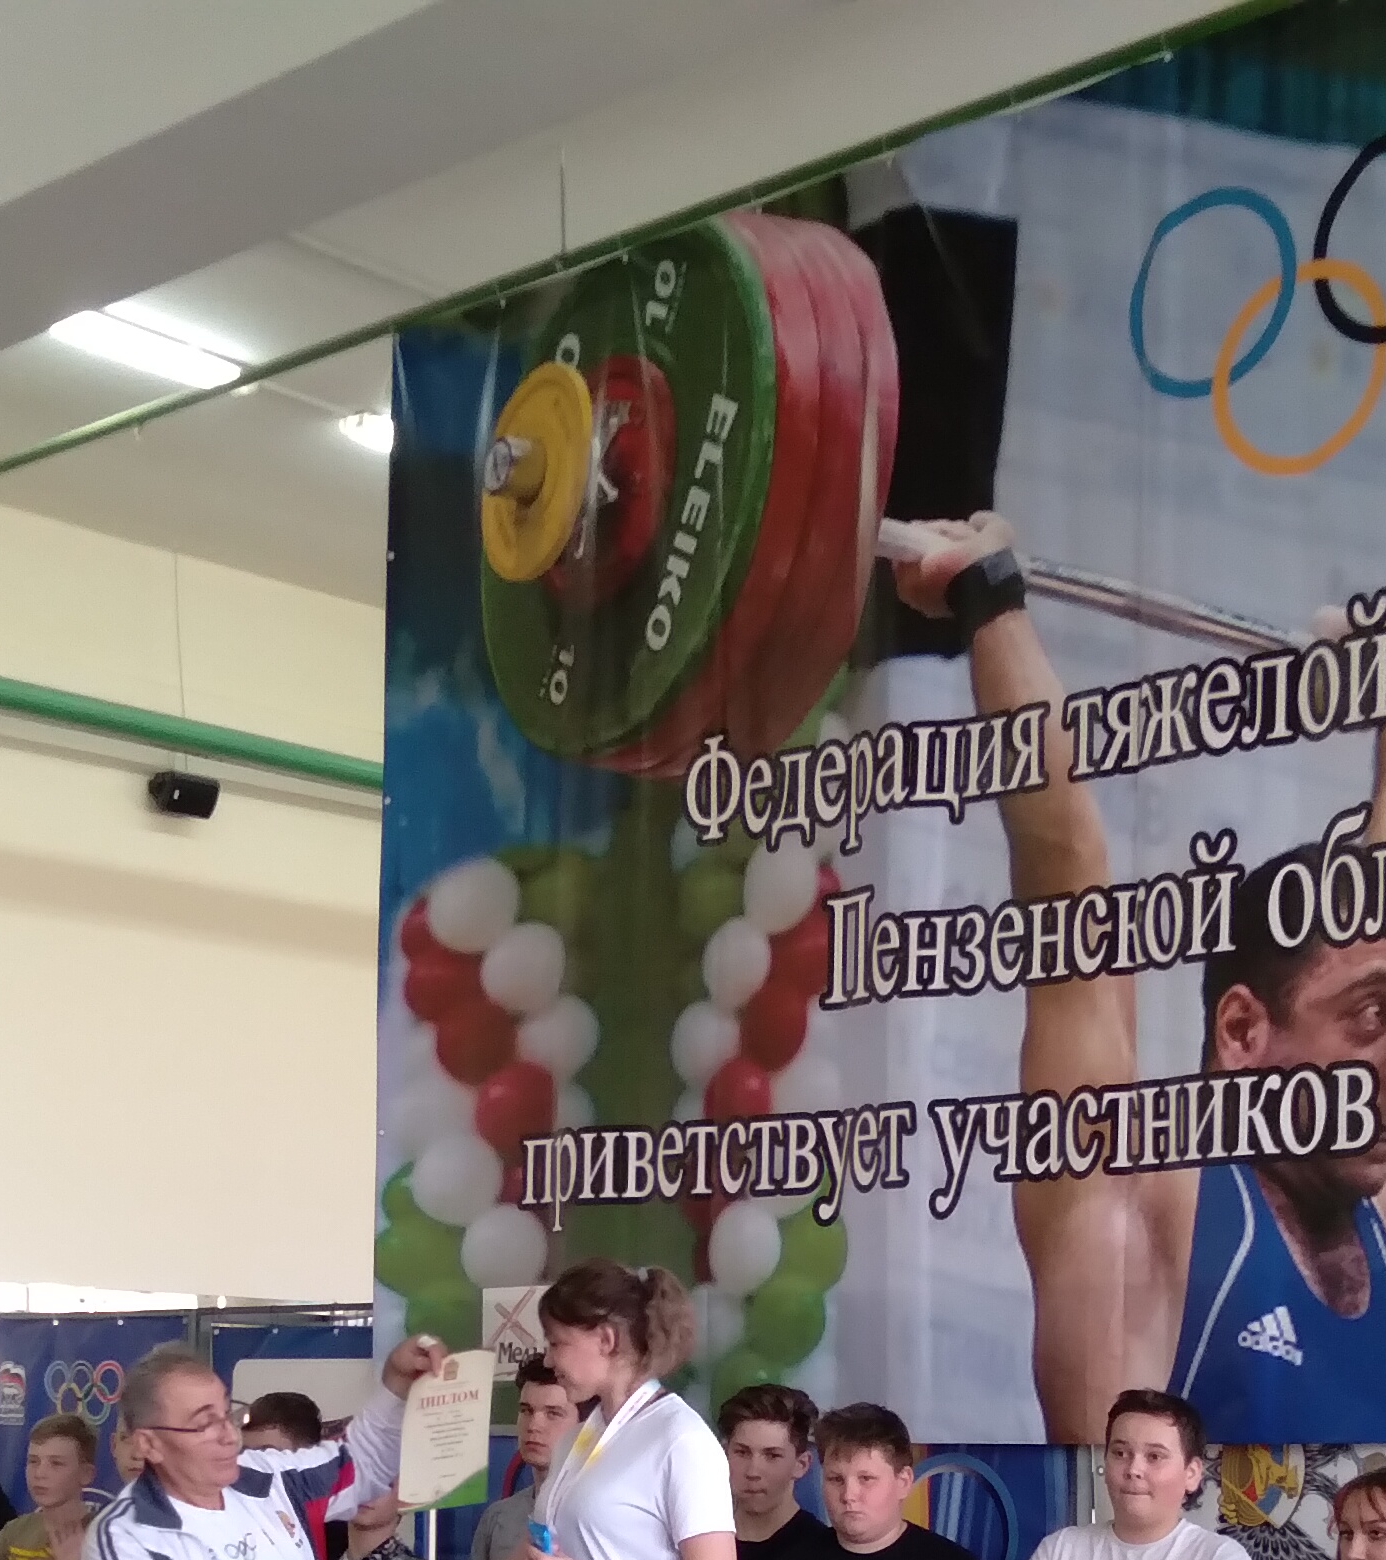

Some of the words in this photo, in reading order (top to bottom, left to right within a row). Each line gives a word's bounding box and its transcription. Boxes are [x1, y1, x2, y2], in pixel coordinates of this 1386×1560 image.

[644, 393, 739, 653] ELEIKO
[683, 704, 1051, 856] Федерация
[821, 830, 1241, 1008] Пензенской
[521, 1101, 915, 1233] приветствует
[929, 1060, 1378, 1221] участников
[416, 1388, 480, 1411] ДИПЛОМ
